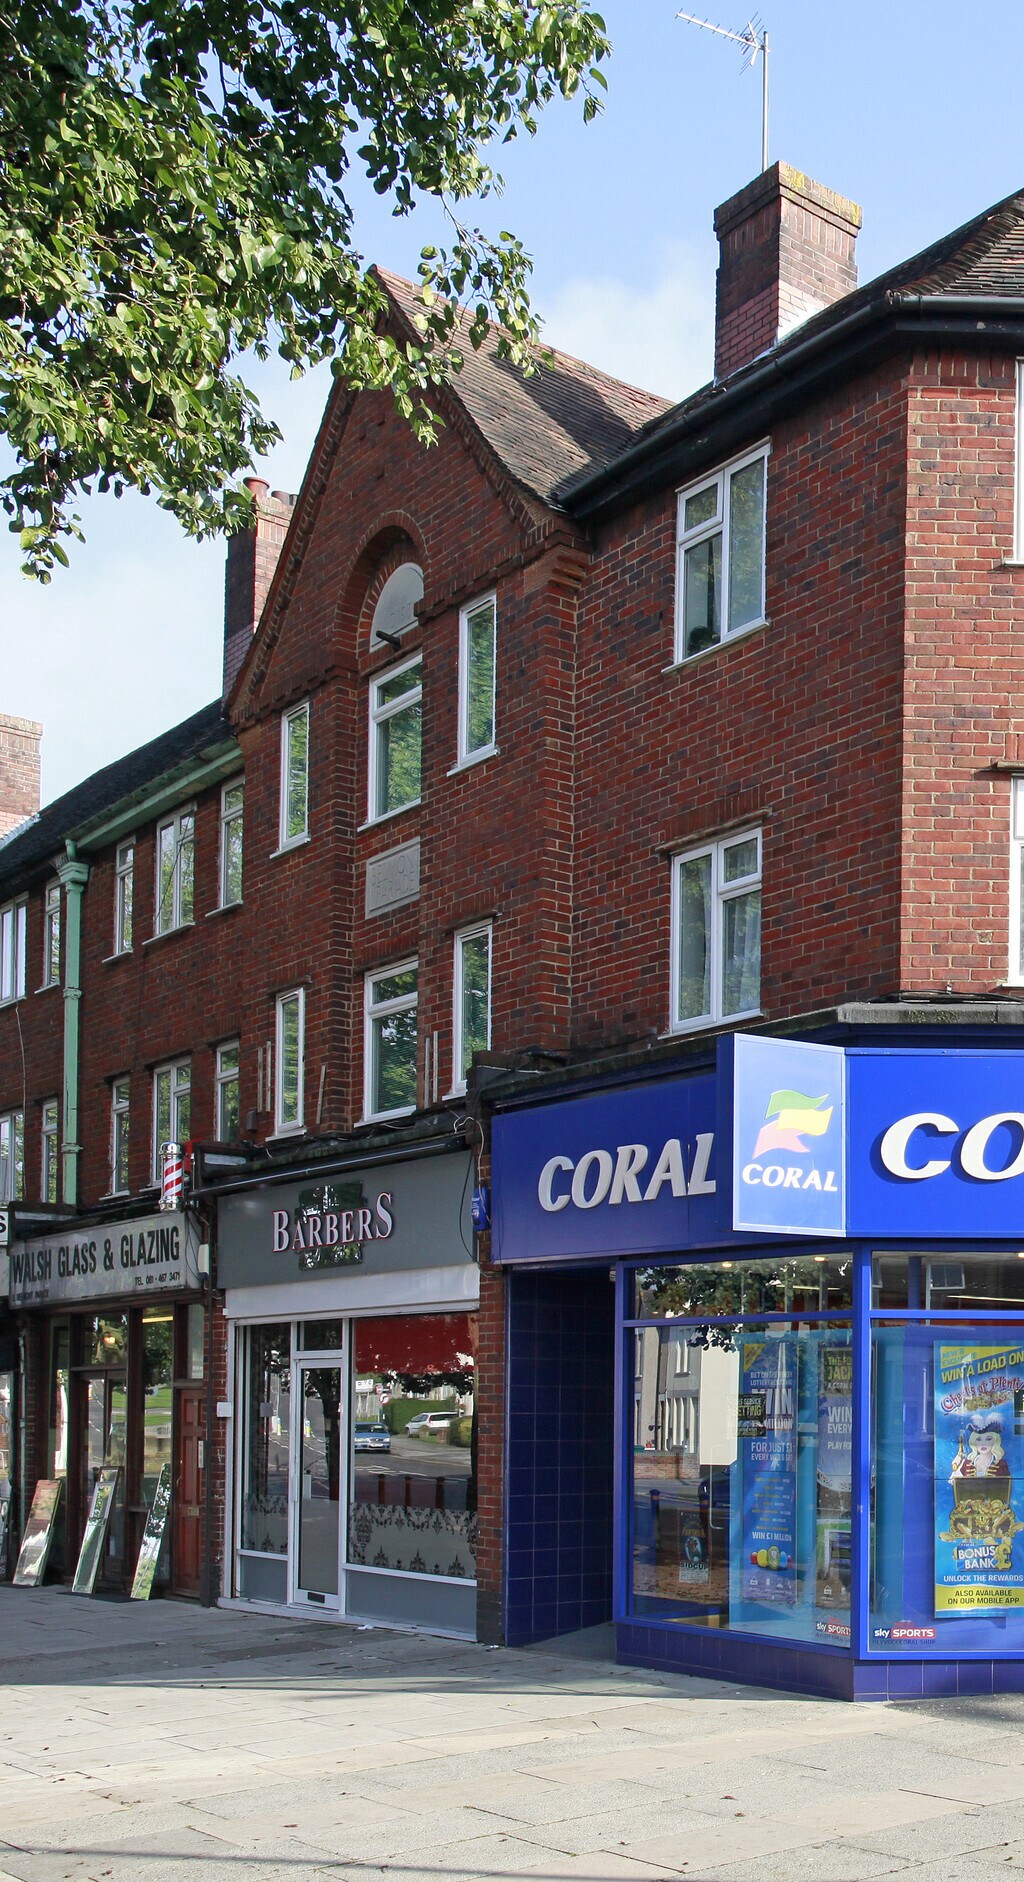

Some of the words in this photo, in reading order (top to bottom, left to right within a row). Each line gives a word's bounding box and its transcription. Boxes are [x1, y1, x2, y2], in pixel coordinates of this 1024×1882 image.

[538, 1132, 717, 1212] CORAL
[742, 1163, 838, 1192] CORAL
[272, 1192, 394, 1252] BARBERS
[12, 1249, 52, 1284] WALSH
[58, 1241, 97, 1277] GLASS
[103, 1238, 114, 1271] &
[120, 1226, 180, 1269] GLAZING
[135, 1276, 143, 1286] TEL
[828, 1356, 842, 1365] THE
[942, 1367, 965, 1383] WIN
[967, 1365, 975, 1376] A
[977, 1356, 1006, 1373] LOAD
[1009, 1351, 1024, 1365] ON
[941, 1386, 976, 1412] Chets
[737, 1405, 762, 1416] ETTING
[828, 1406, 852, 1422] WIN
[828, 1424, 852, 1434] EVERY
[751, 1442, 767, 1452] FOR
[828, 1441, 842, 1449] PLAY
[958, 1546, 996, 1560] BONUS
[965, 1558, 996, 1569] BANK
[816, 1621, 827, 1633] sky
[874, 1629, 890, 1639] sky
[892, 1629, 934, 1638] SPORTS
